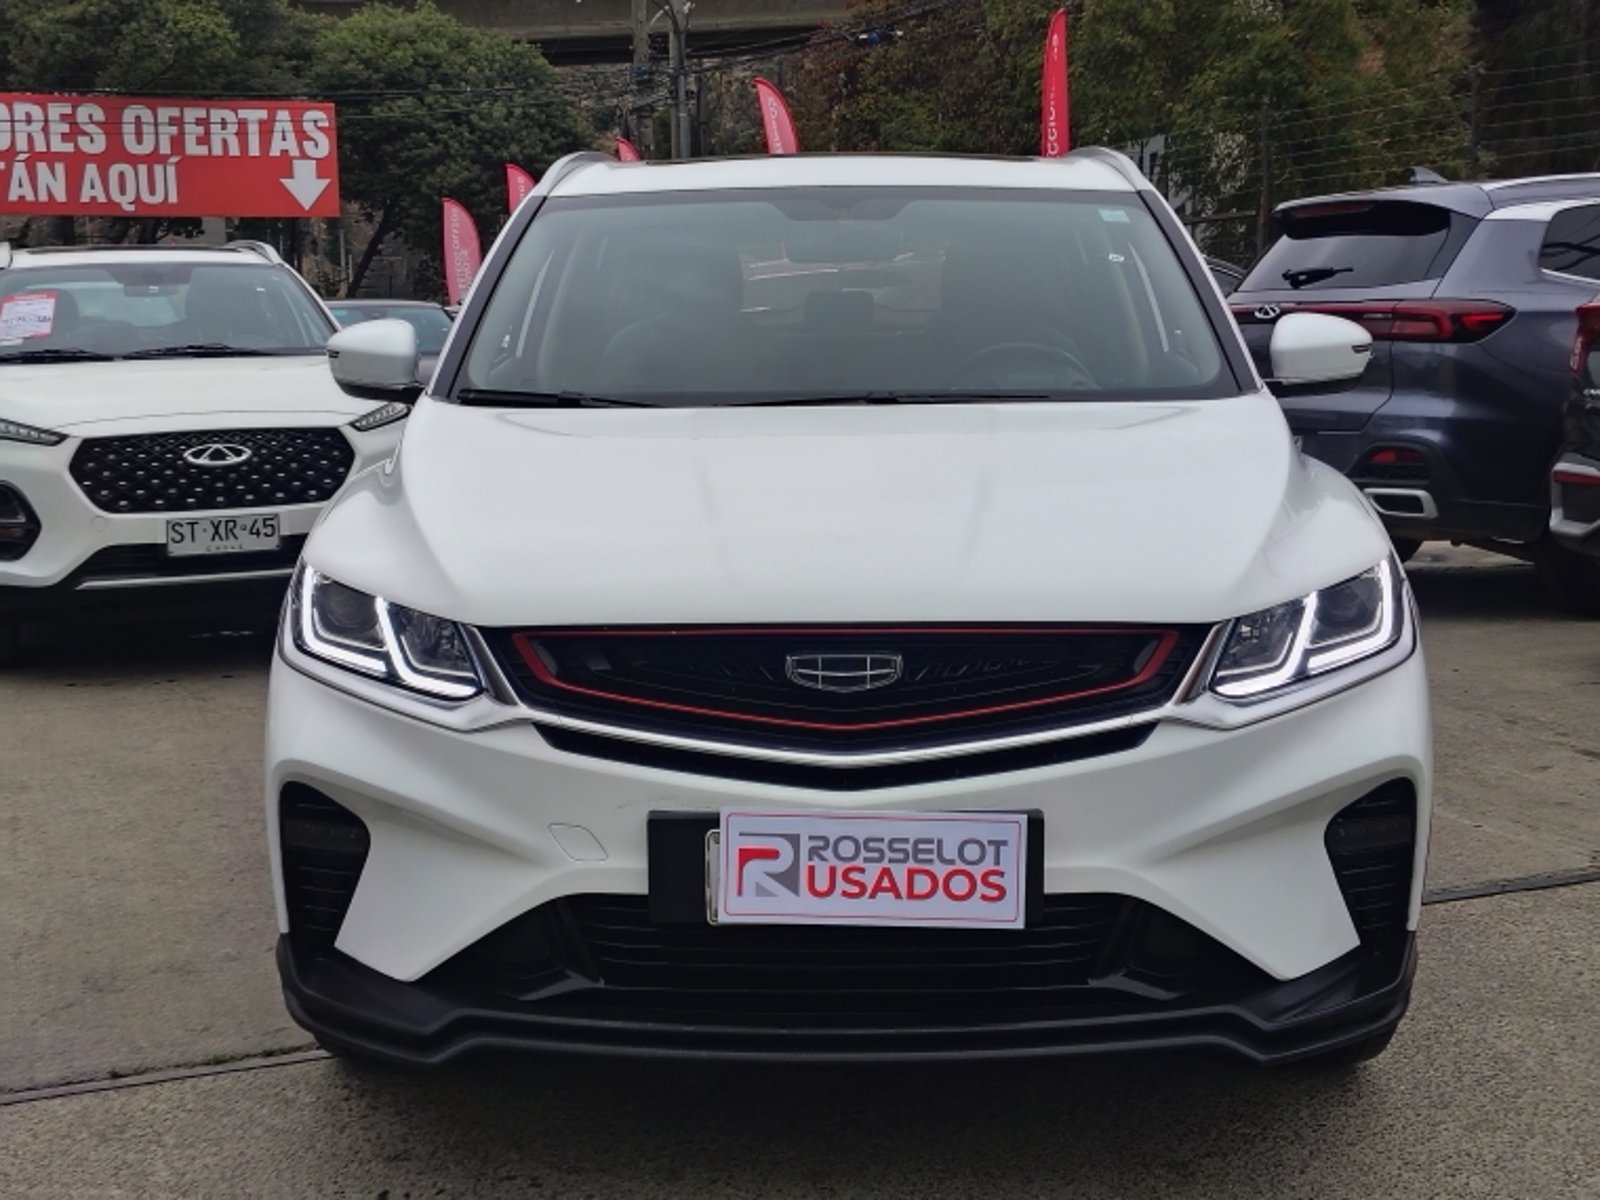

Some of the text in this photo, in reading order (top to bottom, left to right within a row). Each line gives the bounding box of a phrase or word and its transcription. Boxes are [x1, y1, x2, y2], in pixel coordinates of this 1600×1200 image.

[121, 104, 330, 159] OFERTAS
[0, 153, 182, 211] ÁN AQUÍ
[808, 835, 1008, 866] ROSSELOT
[806, 864, 1007, 903] USADOS
